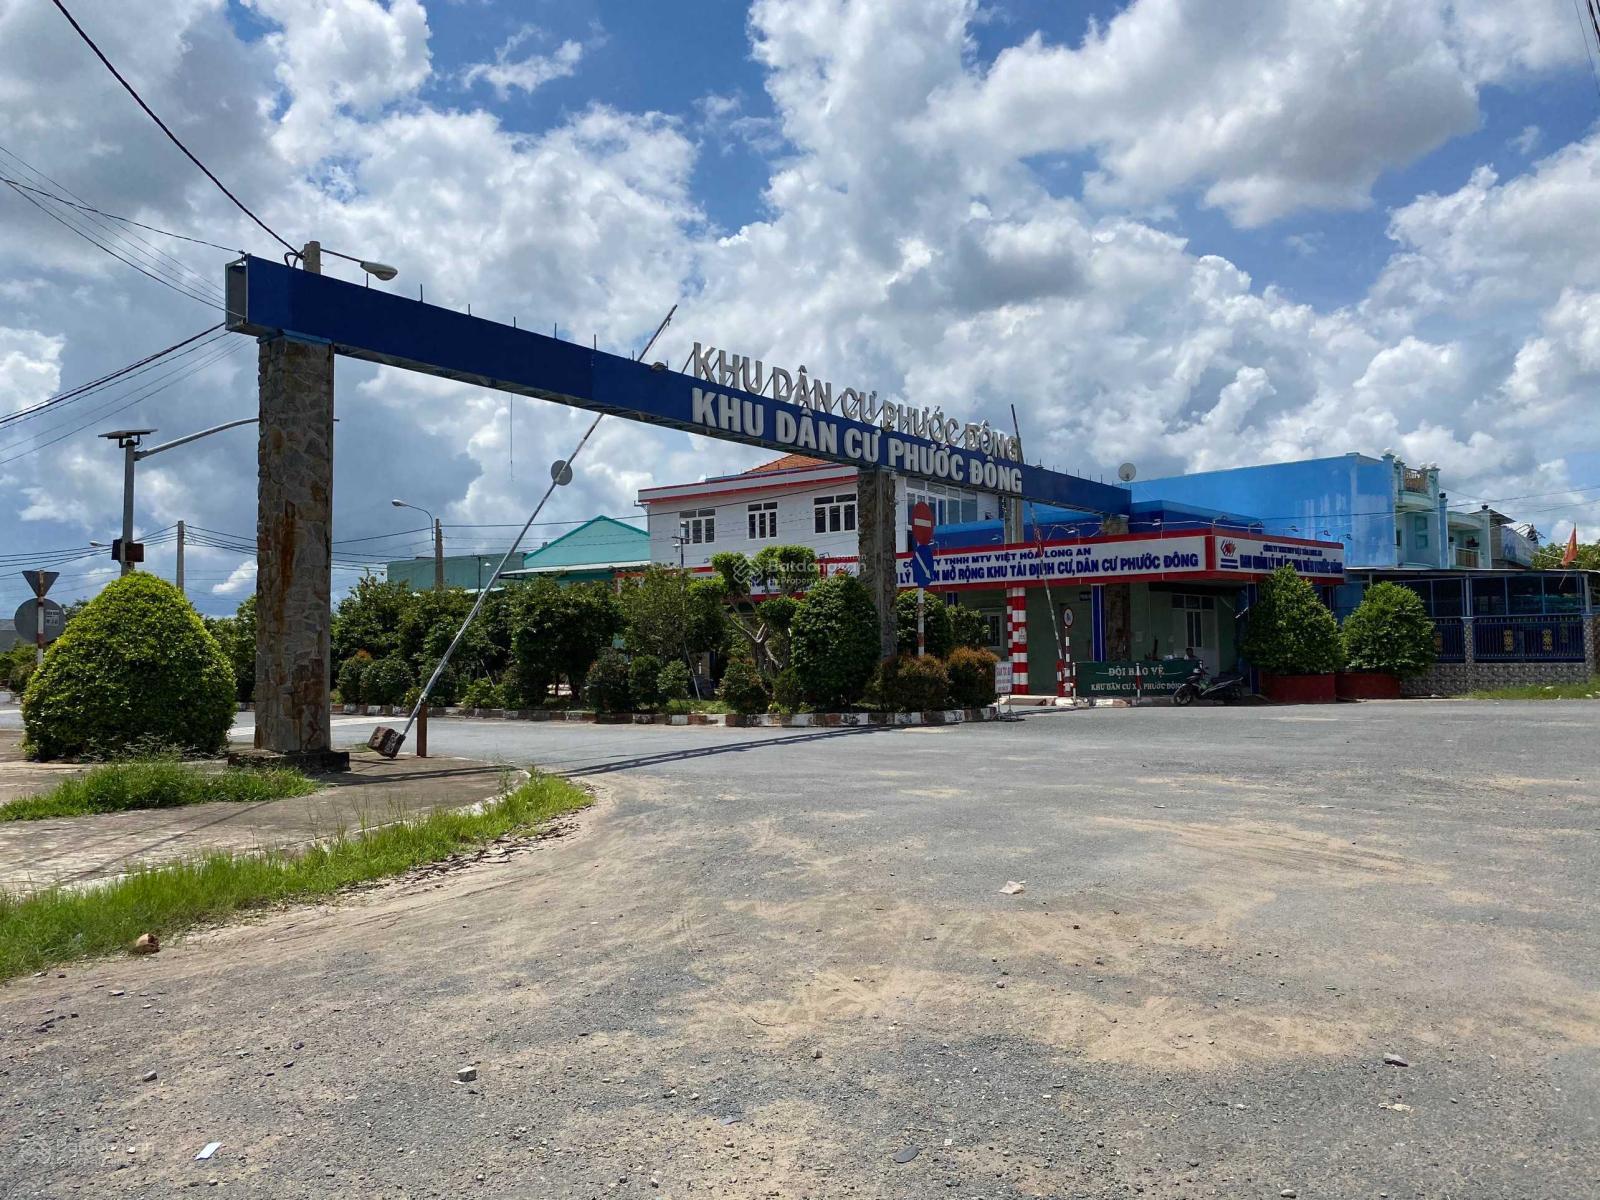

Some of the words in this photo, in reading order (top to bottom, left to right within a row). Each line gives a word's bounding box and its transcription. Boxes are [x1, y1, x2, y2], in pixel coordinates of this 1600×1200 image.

[693, 341, 763, 394] KHU
[773, 364, 832, 414] DÂN
[841, 387, 878, 424] CƯ
[883, 400, 960, 447] PHƯỚC
[965, 418, 1021, 463] ĐÔNG
[691, 387, 764, 437] KHU
[775, 407, 838, 455] DÂN
[844, 427, 882, 462] CƯ
[888, 437, 964, 481] PHƯỚC
[969, 455, 1023, 494] ĐÔNG
[900, 569, 911, 584] LÝ
[958, 566, 986, 584] RỘNG
[986, 563, 1008, 579] KHU
[1009, 561, 1027, 577] TÁI
[1101, 555, 1119, 572] CƯ
[1120, 552, 1161, 571] PHƯỚC
[1163, 551, 1200, 568] ĐÔNG
[944, 556, 970, 565] TNHH
[971, 554, 992, 563] MTV
[994, 552, 1017, 563] VIỆT
[1044, 548, 1074, 559] LONG
[1075, 547, 1092, 556] AN
